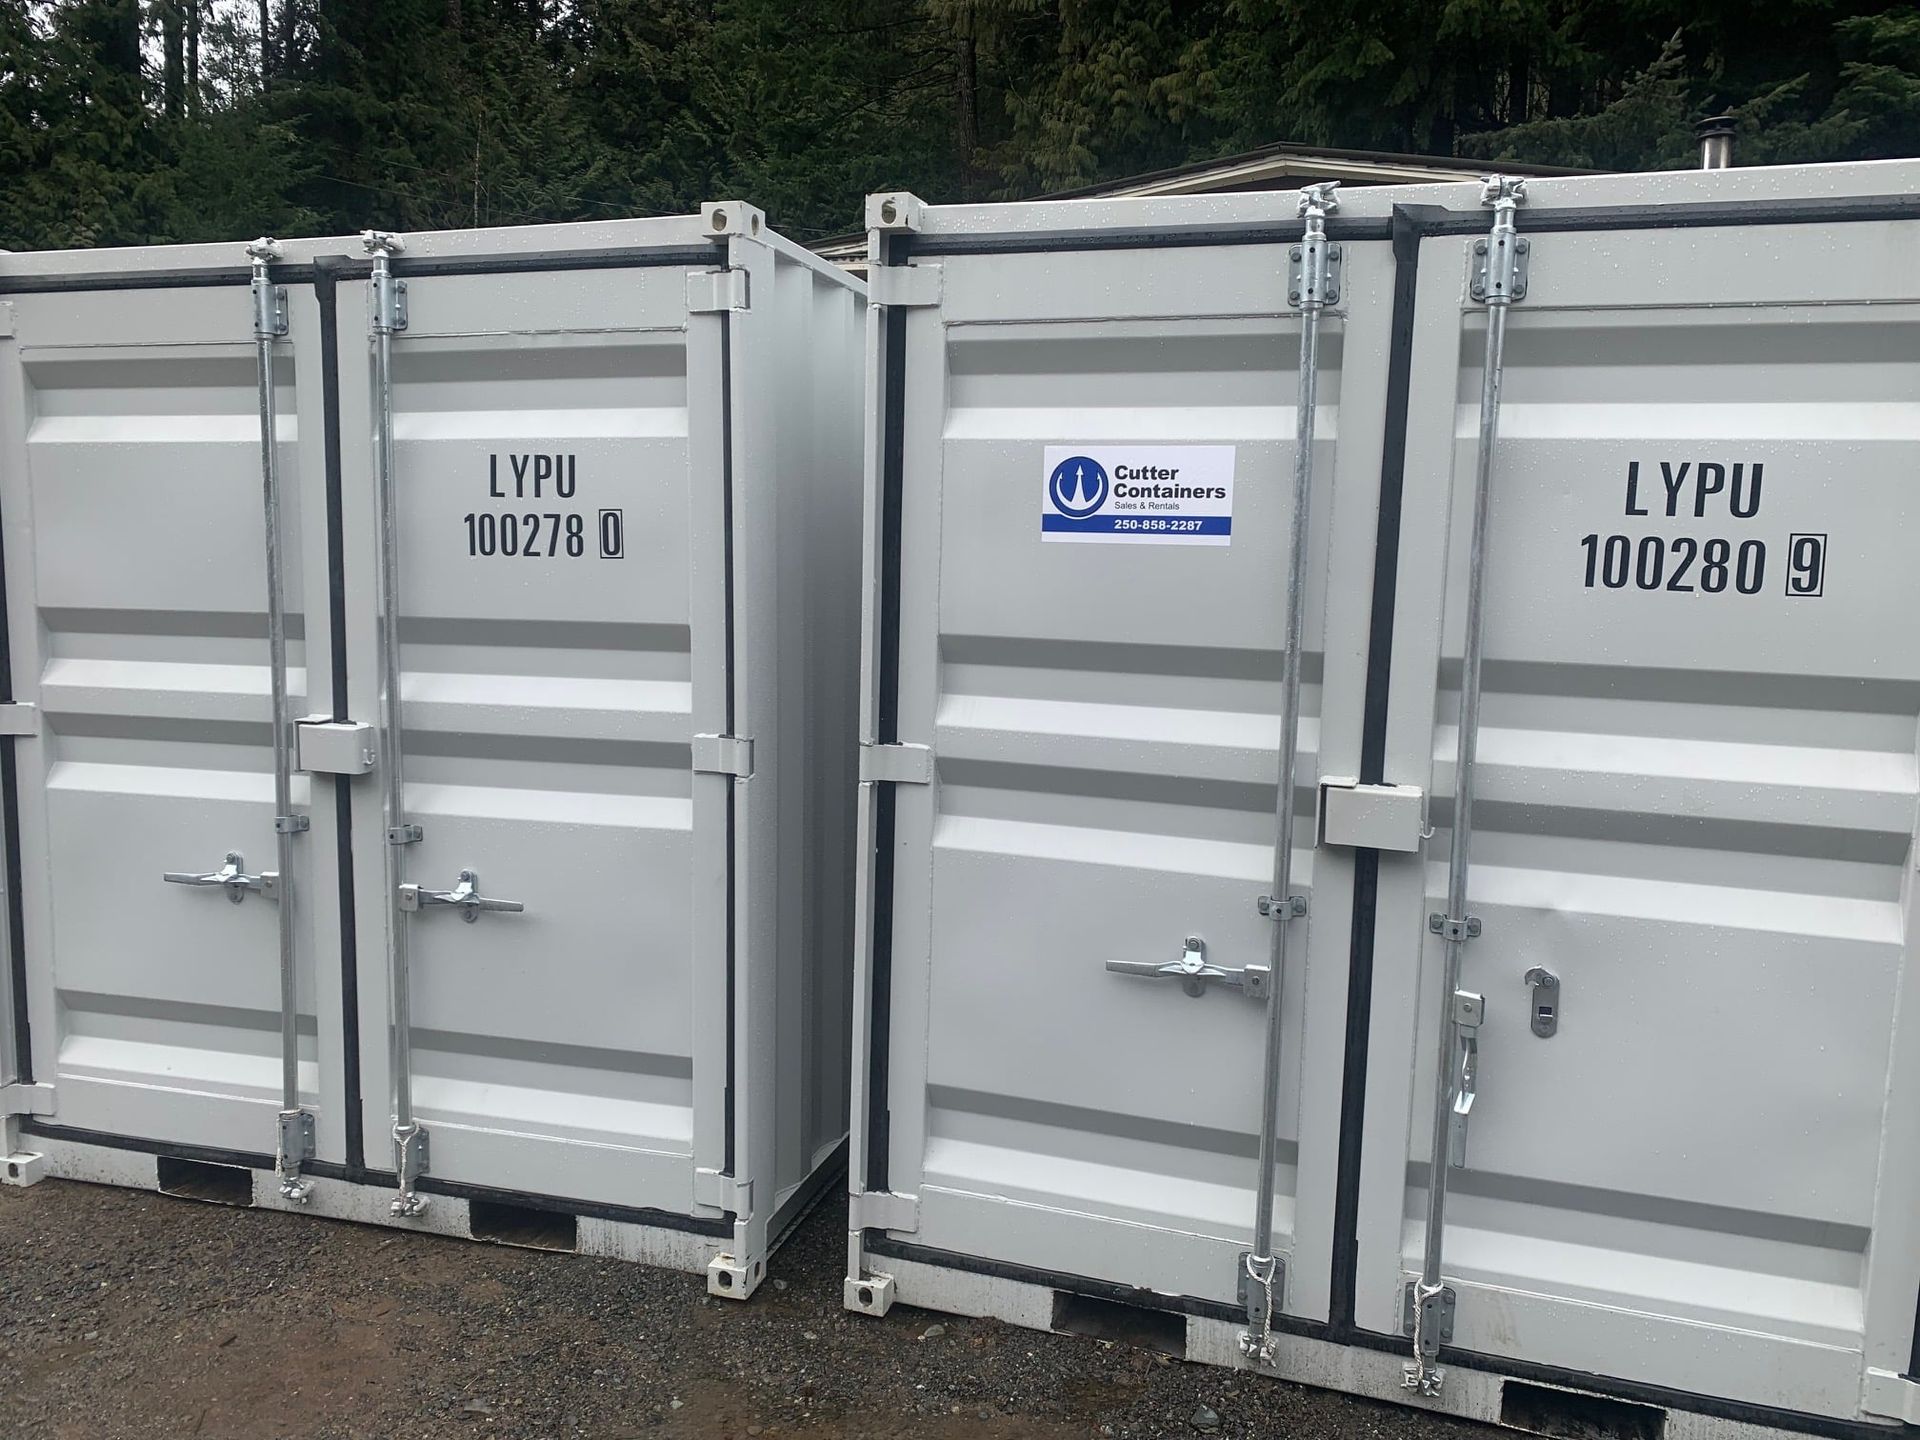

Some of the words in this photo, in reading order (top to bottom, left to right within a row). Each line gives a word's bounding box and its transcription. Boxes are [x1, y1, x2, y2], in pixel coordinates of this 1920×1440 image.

[490, 454, 576, 498] LYPU
[1114, 465, 1179, 480] Cutter
[1113, 483, 1226, 499] Containers
[1625, 461, 1763, 518] LYPU
[1114, 501, 1137, 510] Sales
[1139, 502, 1146, 510] &
[1148, 502, 1180, 511] Rentals
[464, 513, 584, 558] 100278
[602, 512, 621, 556] 0
[1114, 519, 1203, 531] 250-858-2287
[1581, 534, 1766, 595] 100280
[1791, 537, 1821, 593] 9
